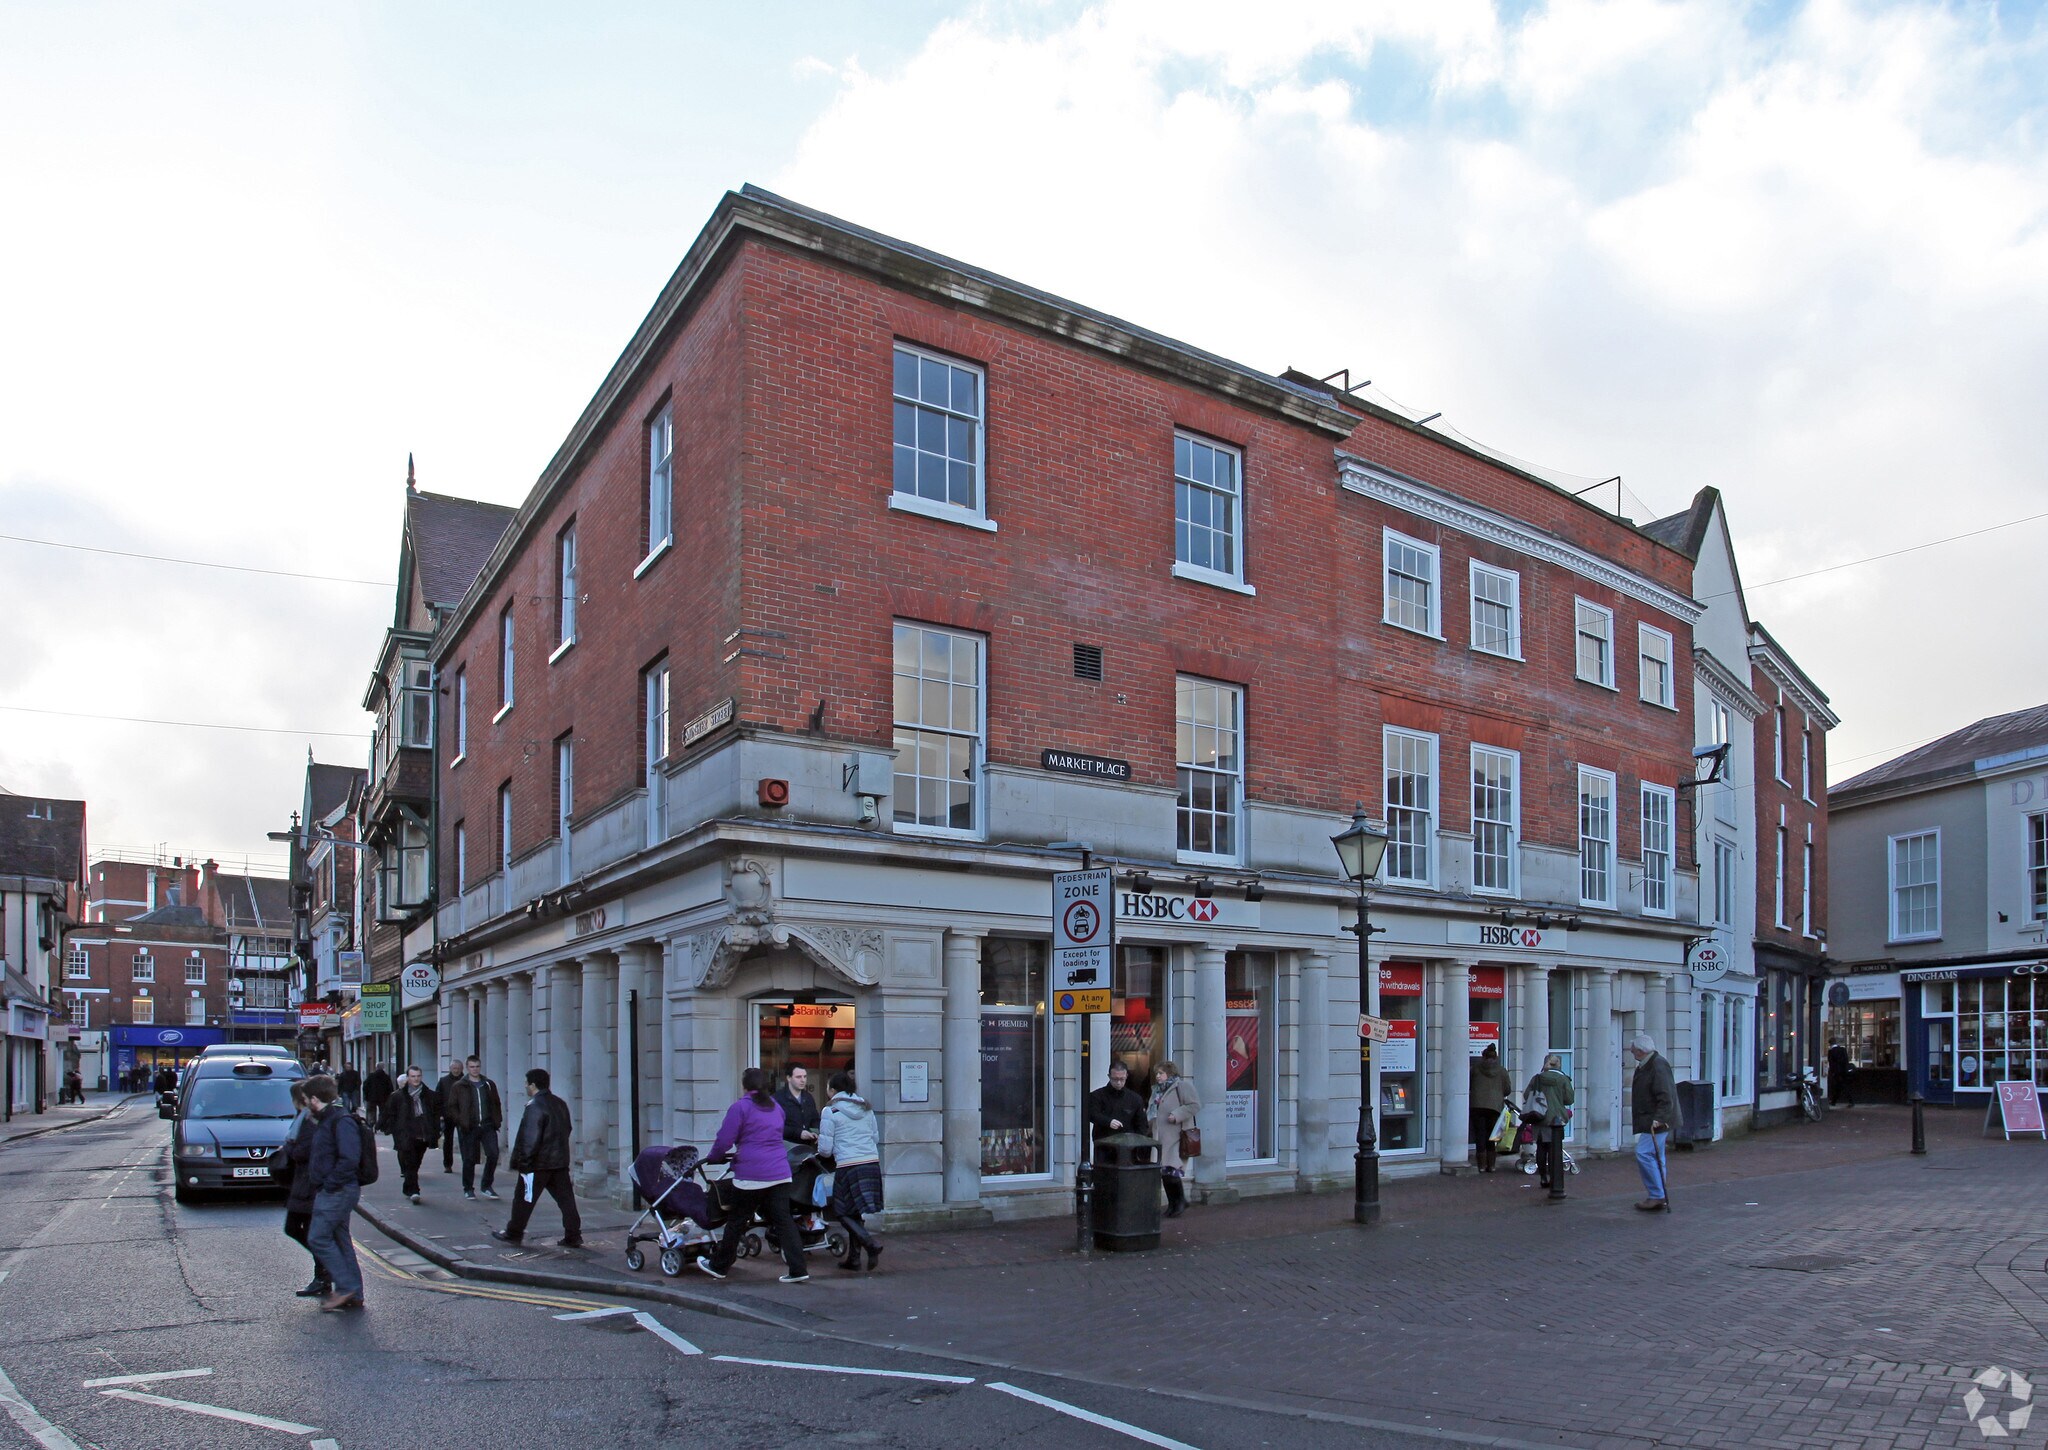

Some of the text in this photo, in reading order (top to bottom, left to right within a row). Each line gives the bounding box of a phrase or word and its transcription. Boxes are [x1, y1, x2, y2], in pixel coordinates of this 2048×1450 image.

[1048, 754, 1126, 776] MARKET PLACE
[1057, 871, 1107, 883] PEDESTRIAN
[1064, 884, 1099, 898] ZONE
[1122, 893, 1185, 920] HSBC
[1479, 925, 1520, 946] HSBC
[1063, 949, 1100, 960] Except for
[1063, 958, 1100, 967] loading by
[1692, 961, 1724, 972] HSBC
[1379, 970, 1392, 979] ee
[1907, 971, 1958, 982] DINGHAMS
[406, 979, 436, 988] HSBC
[1386, 982, 1420, 991] withdrawals
[1472, 985, 1502, 994] withdrawals
[1081, 994, 1104, 1003] At any
[366, 1001, 387, 1009] SHOP
[1085, 1003, 1101, 1011] time
[997, 1020, 1029, 1028] PREMIER
[2003, 1086, 2013, 1102] 3
[2021, 1086, 2033, 1101] 2
[237, 1168, 259, 1176] SF54
